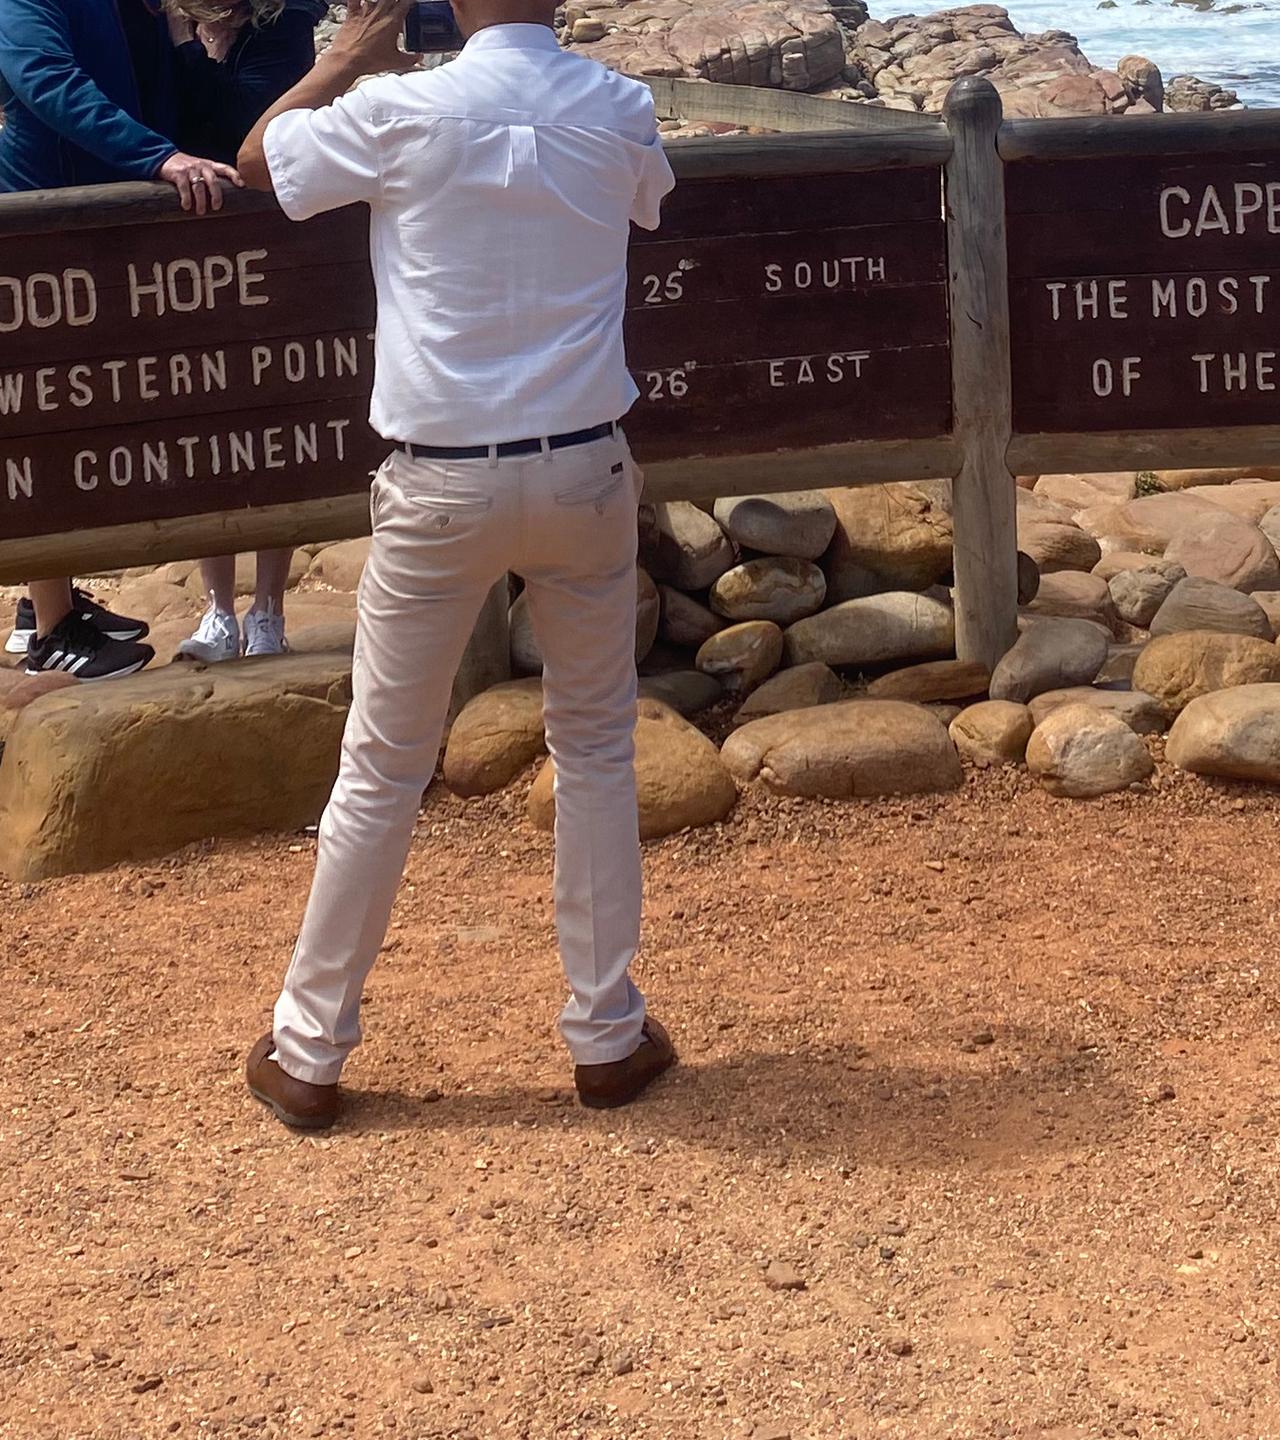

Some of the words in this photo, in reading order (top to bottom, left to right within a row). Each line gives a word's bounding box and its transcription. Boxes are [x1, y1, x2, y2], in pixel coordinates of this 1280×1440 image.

[127, 248, 270, 319] HOPE
[763, 256, 887, 292] SOUTH
[1045, 276, 1130, 322] THE
[1151, 272, 1271, 320] MOST
[251, 333, 375, 387] POIN
[769, 354, 871, 388] EAST
[1091, 356, 1142, 399] OF
[1190, 351, 1277, 394] THE
[73, 418, 351, 492] CONTINENT
